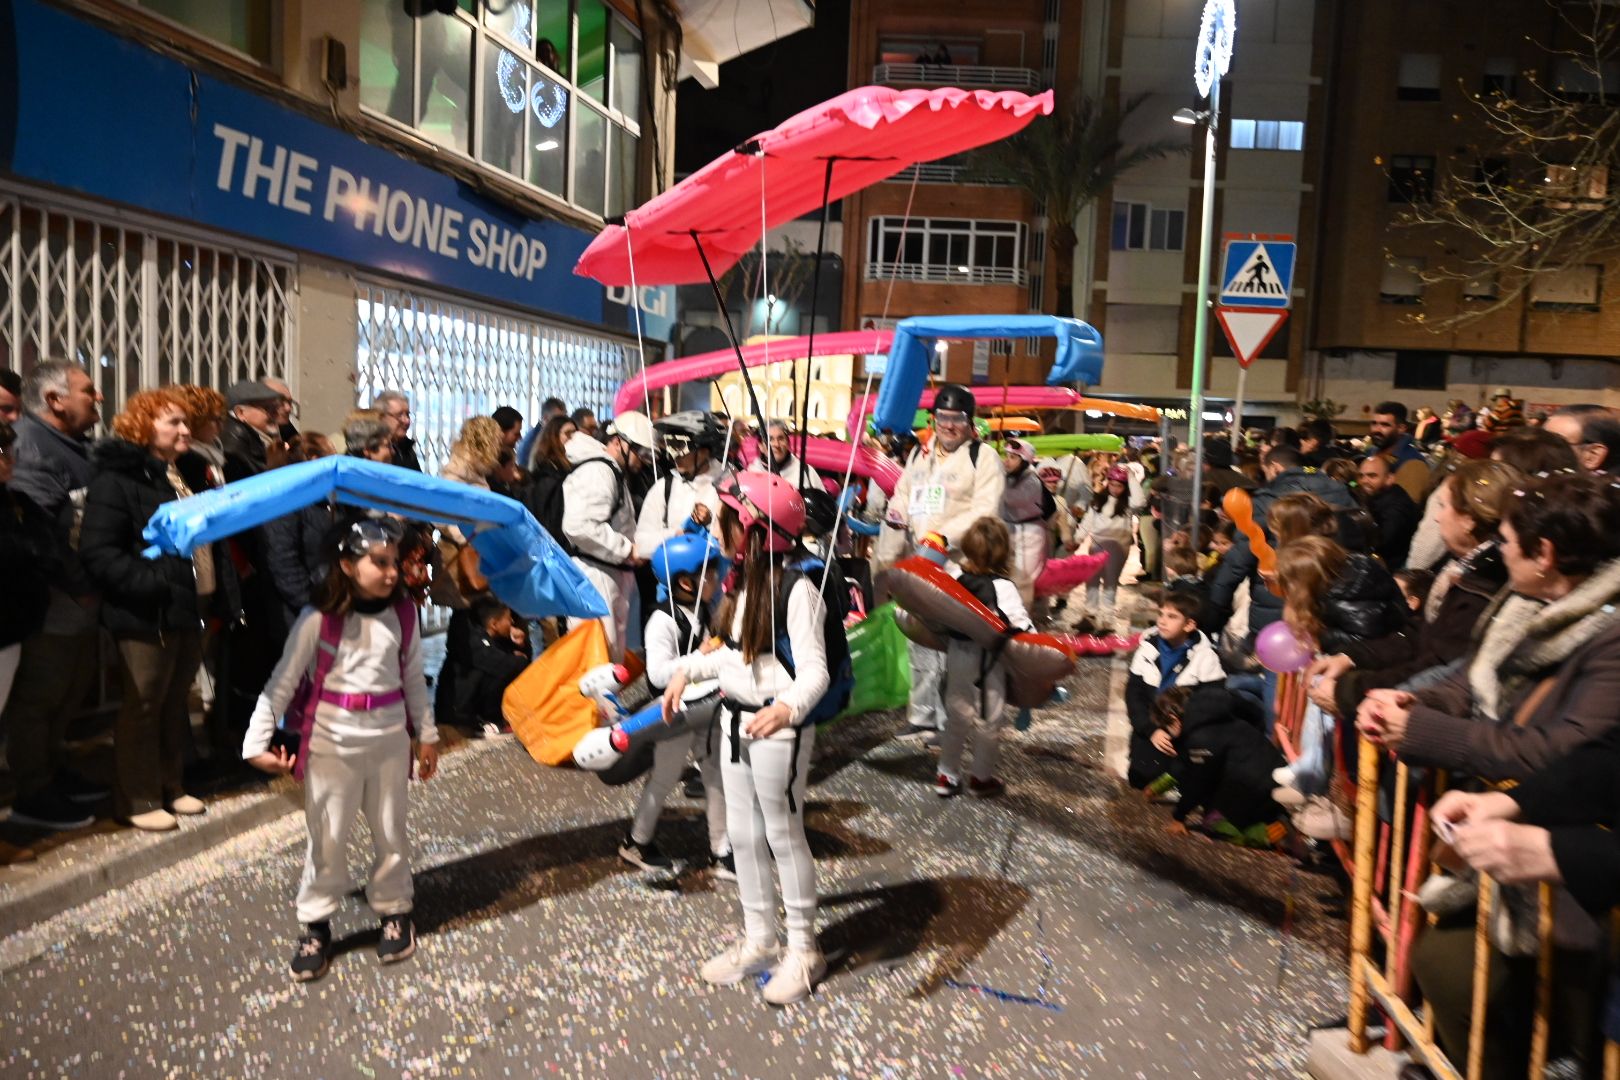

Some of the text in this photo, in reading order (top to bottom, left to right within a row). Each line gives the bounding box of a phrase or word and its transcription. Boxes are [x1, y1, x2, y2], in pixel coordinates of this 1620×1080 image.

[213, 122, 547, 282] THE PHONE SHOP
[606, 285, 667, 319] DIGI
